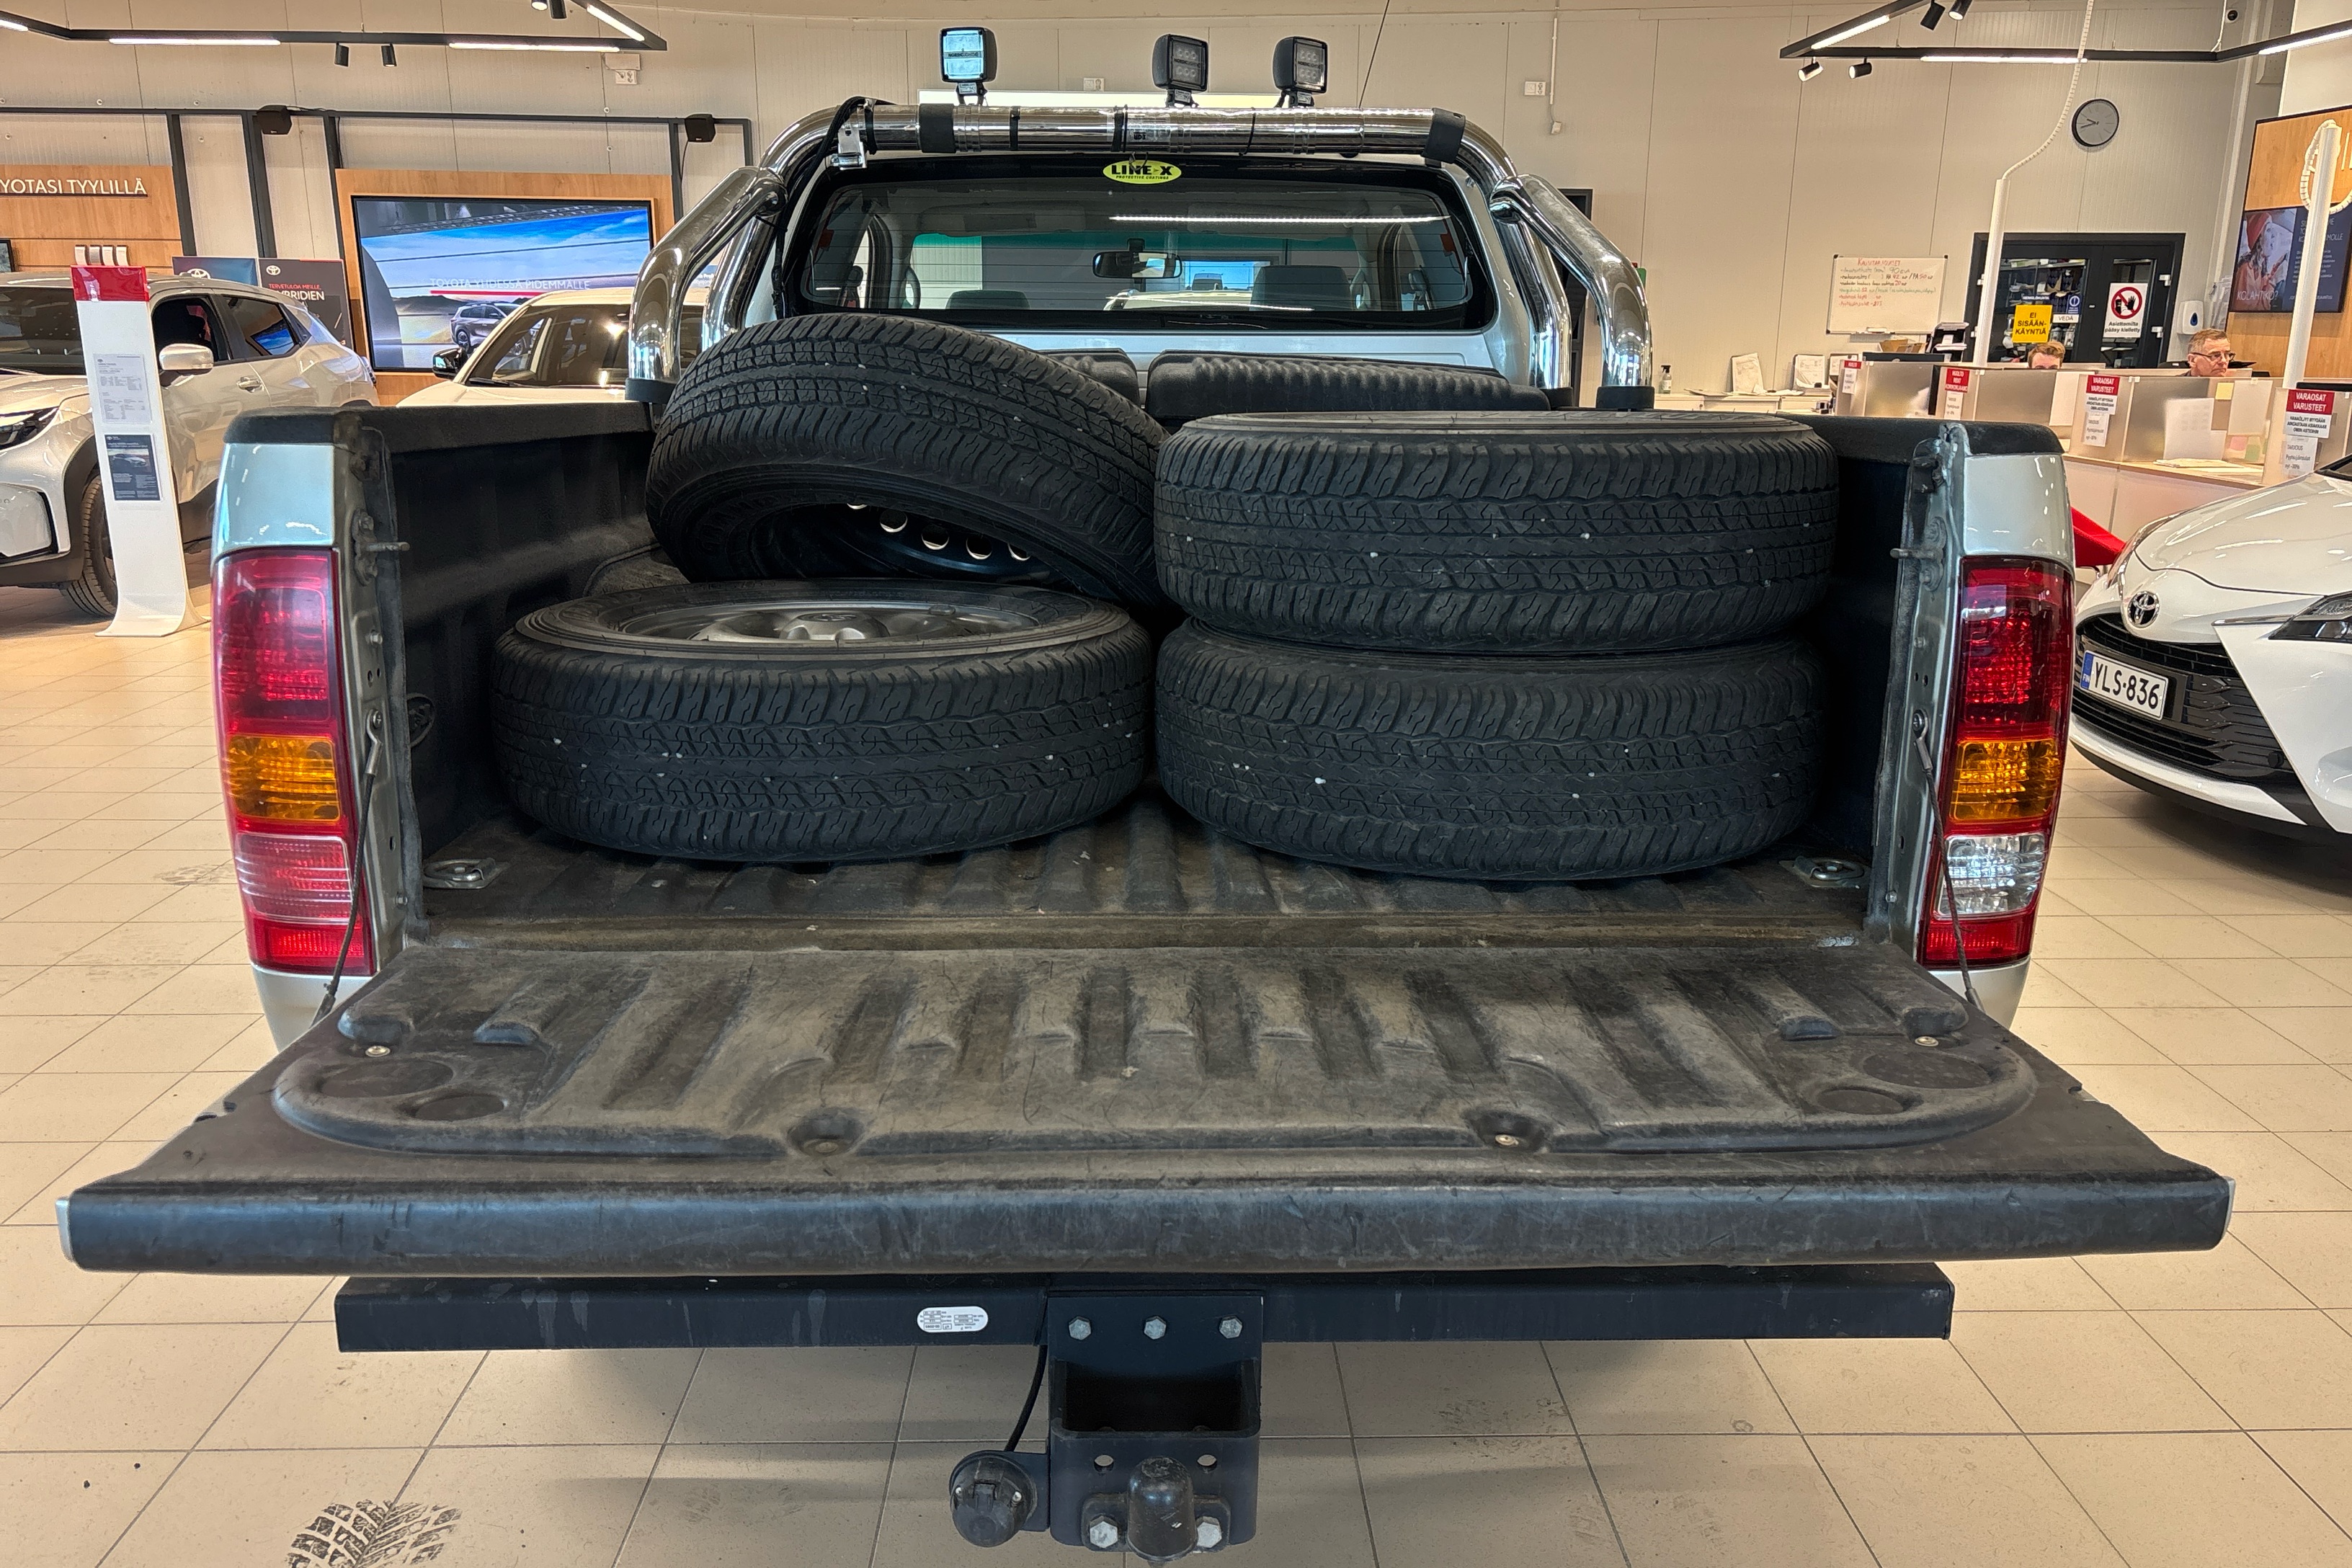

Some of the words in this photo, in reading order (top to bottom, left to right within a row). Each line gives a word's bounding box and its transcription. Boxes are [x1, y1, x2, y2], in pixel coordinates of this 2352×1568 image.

[67, 178, 146, 195] TYYLILLÄ
[429, 277, 468, 287] TOYOTA
[473, 277, 522, 288] YHDESSÄ
[525, 278, 590, 290] PIDEMMÄLLE
[276, 290, 325, 300] YBRIDIEN
[2017, 318, 2047, 326] SISÄÄN-
[2015, 326, 2046, 335] KÄYNTIÄ
[2296, 392, 2327, 401] VARAOSAT
[2293, 402, 2327, 412] VARUSTEET
[2095, 662, 2160, 710] YLS-836
